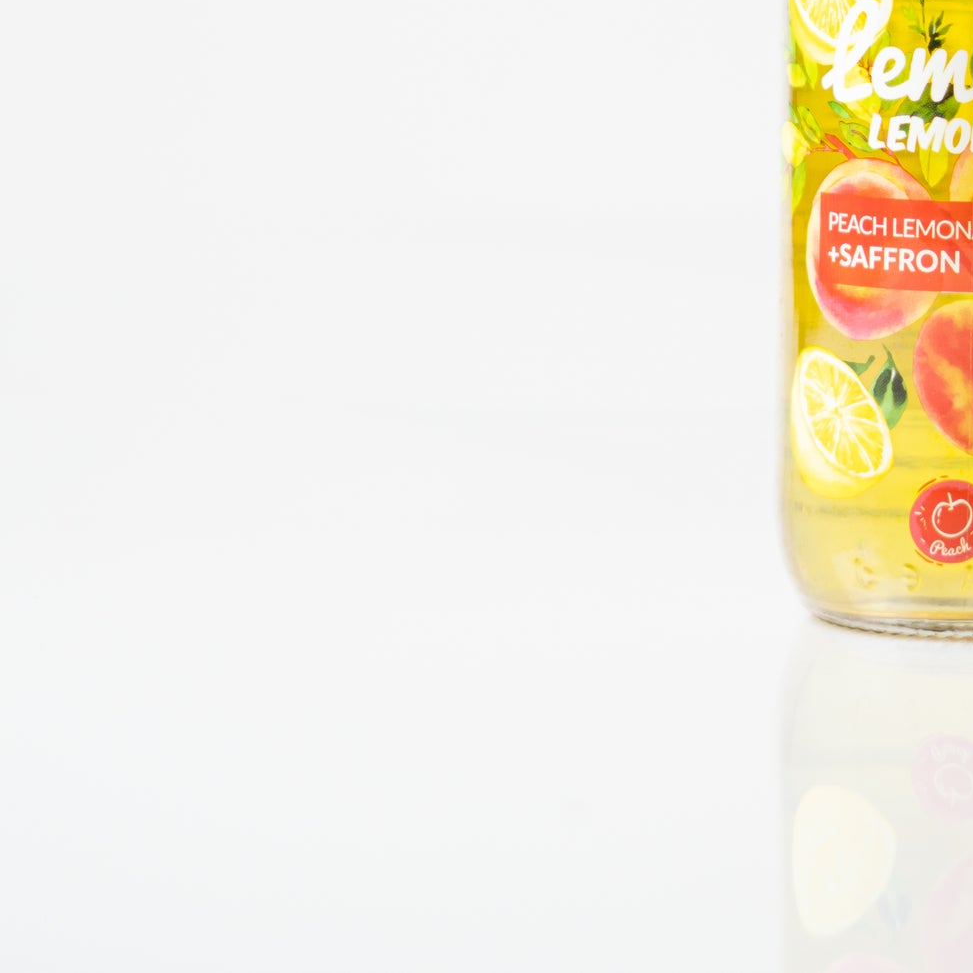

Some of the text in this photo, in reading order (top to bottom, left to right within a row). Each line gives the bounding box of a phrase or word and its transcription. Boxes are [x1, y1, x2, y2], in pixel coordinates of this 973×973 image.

[828, 211, 888, 237] PEACH
[827, 243, 961, 274] +SAFFRON
[929, 536, 972, 557] Peach
